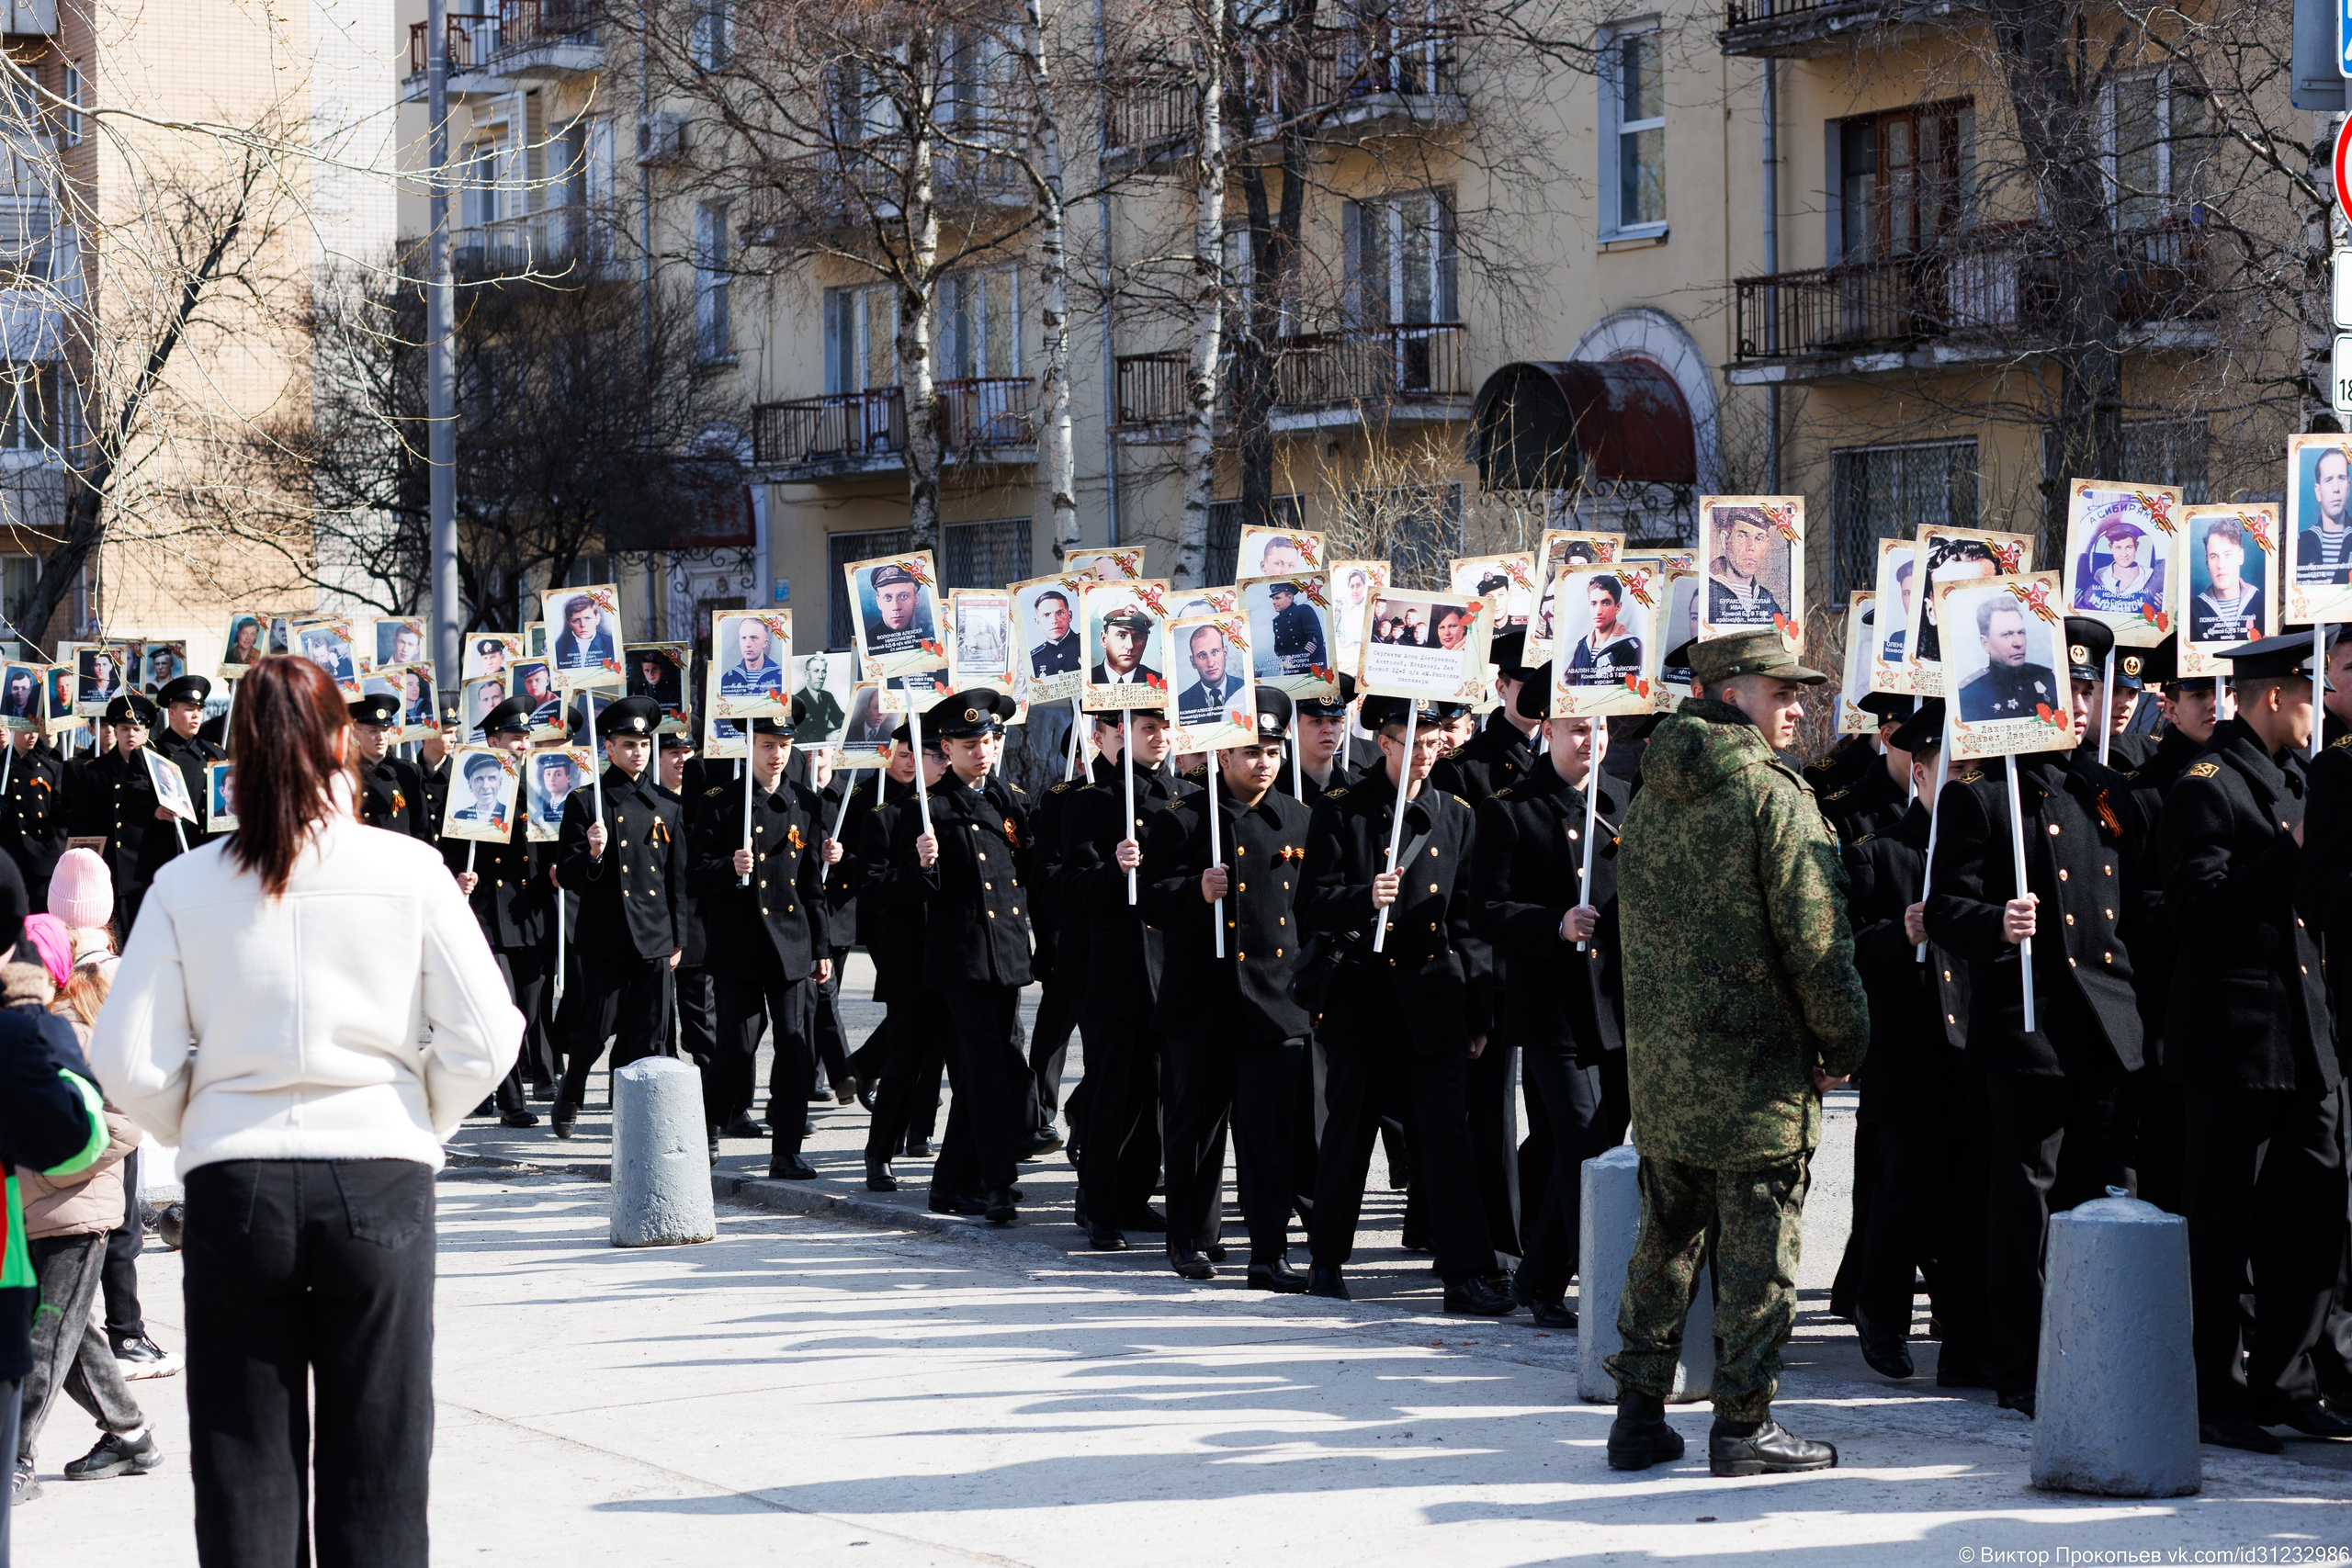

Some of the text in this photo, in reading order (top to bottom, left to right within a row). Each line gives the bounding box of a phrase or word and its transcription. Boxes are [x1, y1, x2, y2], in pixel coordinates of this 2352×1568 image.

[876, 627, 922, 640] ВОЛОЧКОВ АЛЕКСЕЙ
[885, 635, 916, 643] НИКОЛАЕВИЧ
[1058, 672, 1081, 682] Шмеле
[1915, 669, 1942, 678] Борис
[1969, 729, 2055, 744] Павел Иванович
